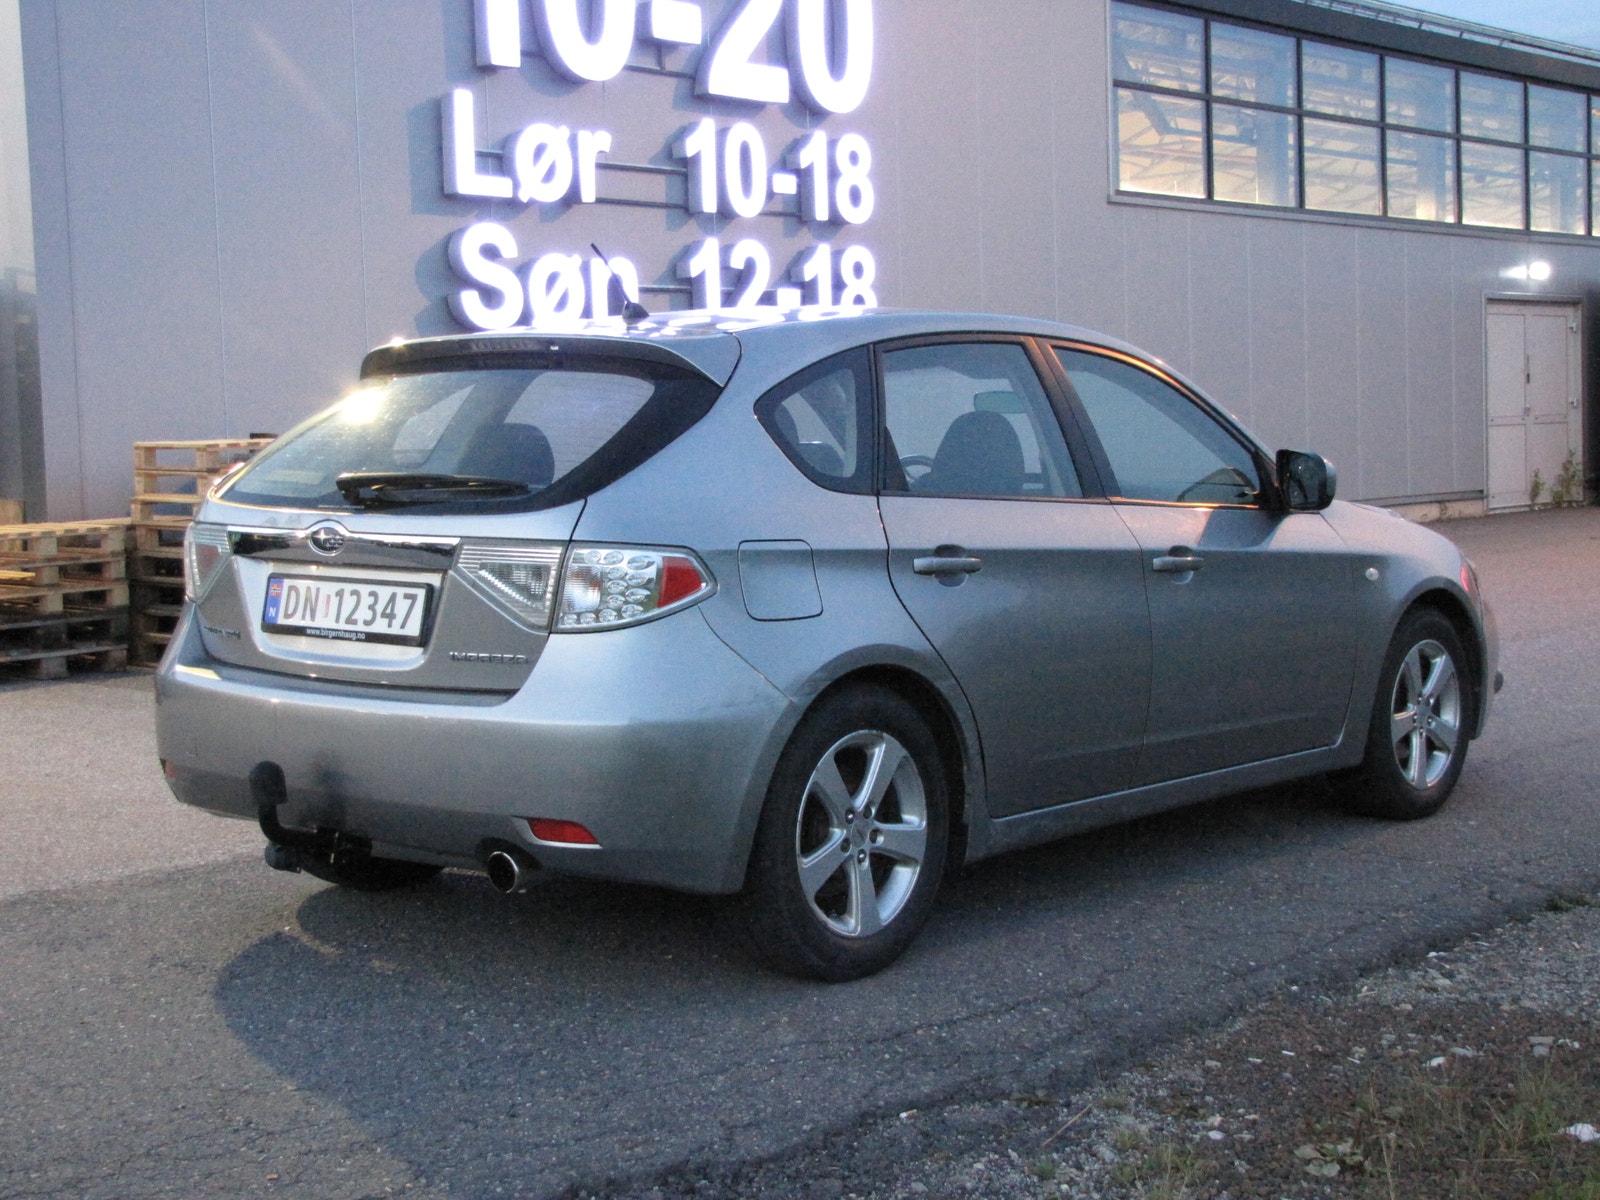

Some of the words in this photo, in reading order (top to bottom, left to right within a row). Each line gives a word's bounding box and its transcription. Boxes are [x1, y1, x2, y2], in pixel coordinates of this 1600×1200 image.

[453, 89, 612, 203] Lør
[686, 118, 875, 224] 10-18
[460, 222, 640, 330] Søn
[690, 237, 877, 310] 12-18
[268, 607, 276, 617] N
[283, 585, 320, 622] DN
[334, 588, 418, 629] 12347
[306, 628, 366, 641] www.birgernhaug.no
